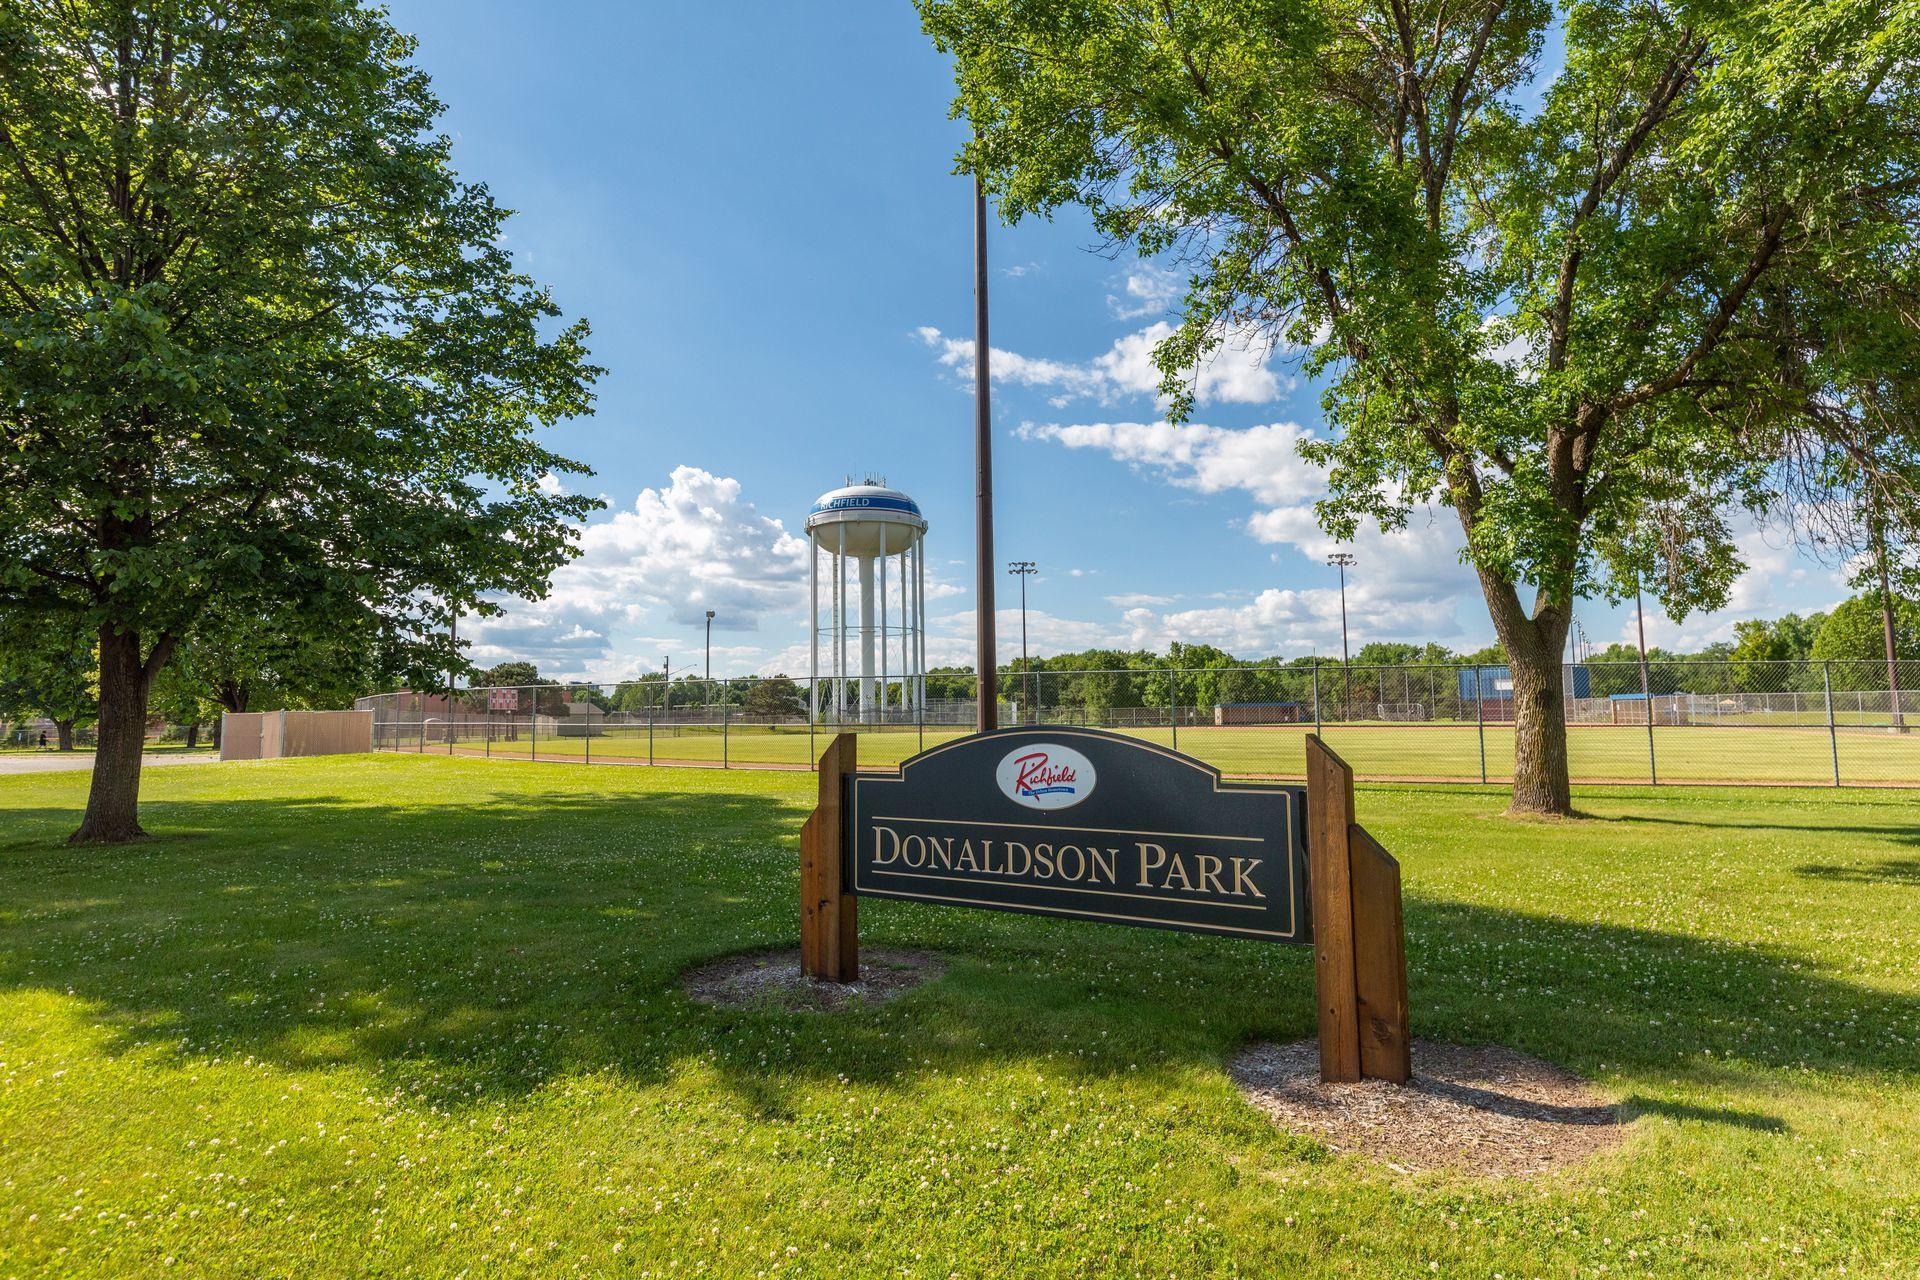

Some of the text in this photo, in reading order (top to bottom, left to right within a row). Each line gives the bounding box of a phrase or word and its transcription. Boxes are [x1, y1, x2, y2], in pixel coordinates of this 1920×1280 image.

[1013, 752, 1077, 803] Richfield
[871, 826, 1267, 898] DONALDSON PARK
